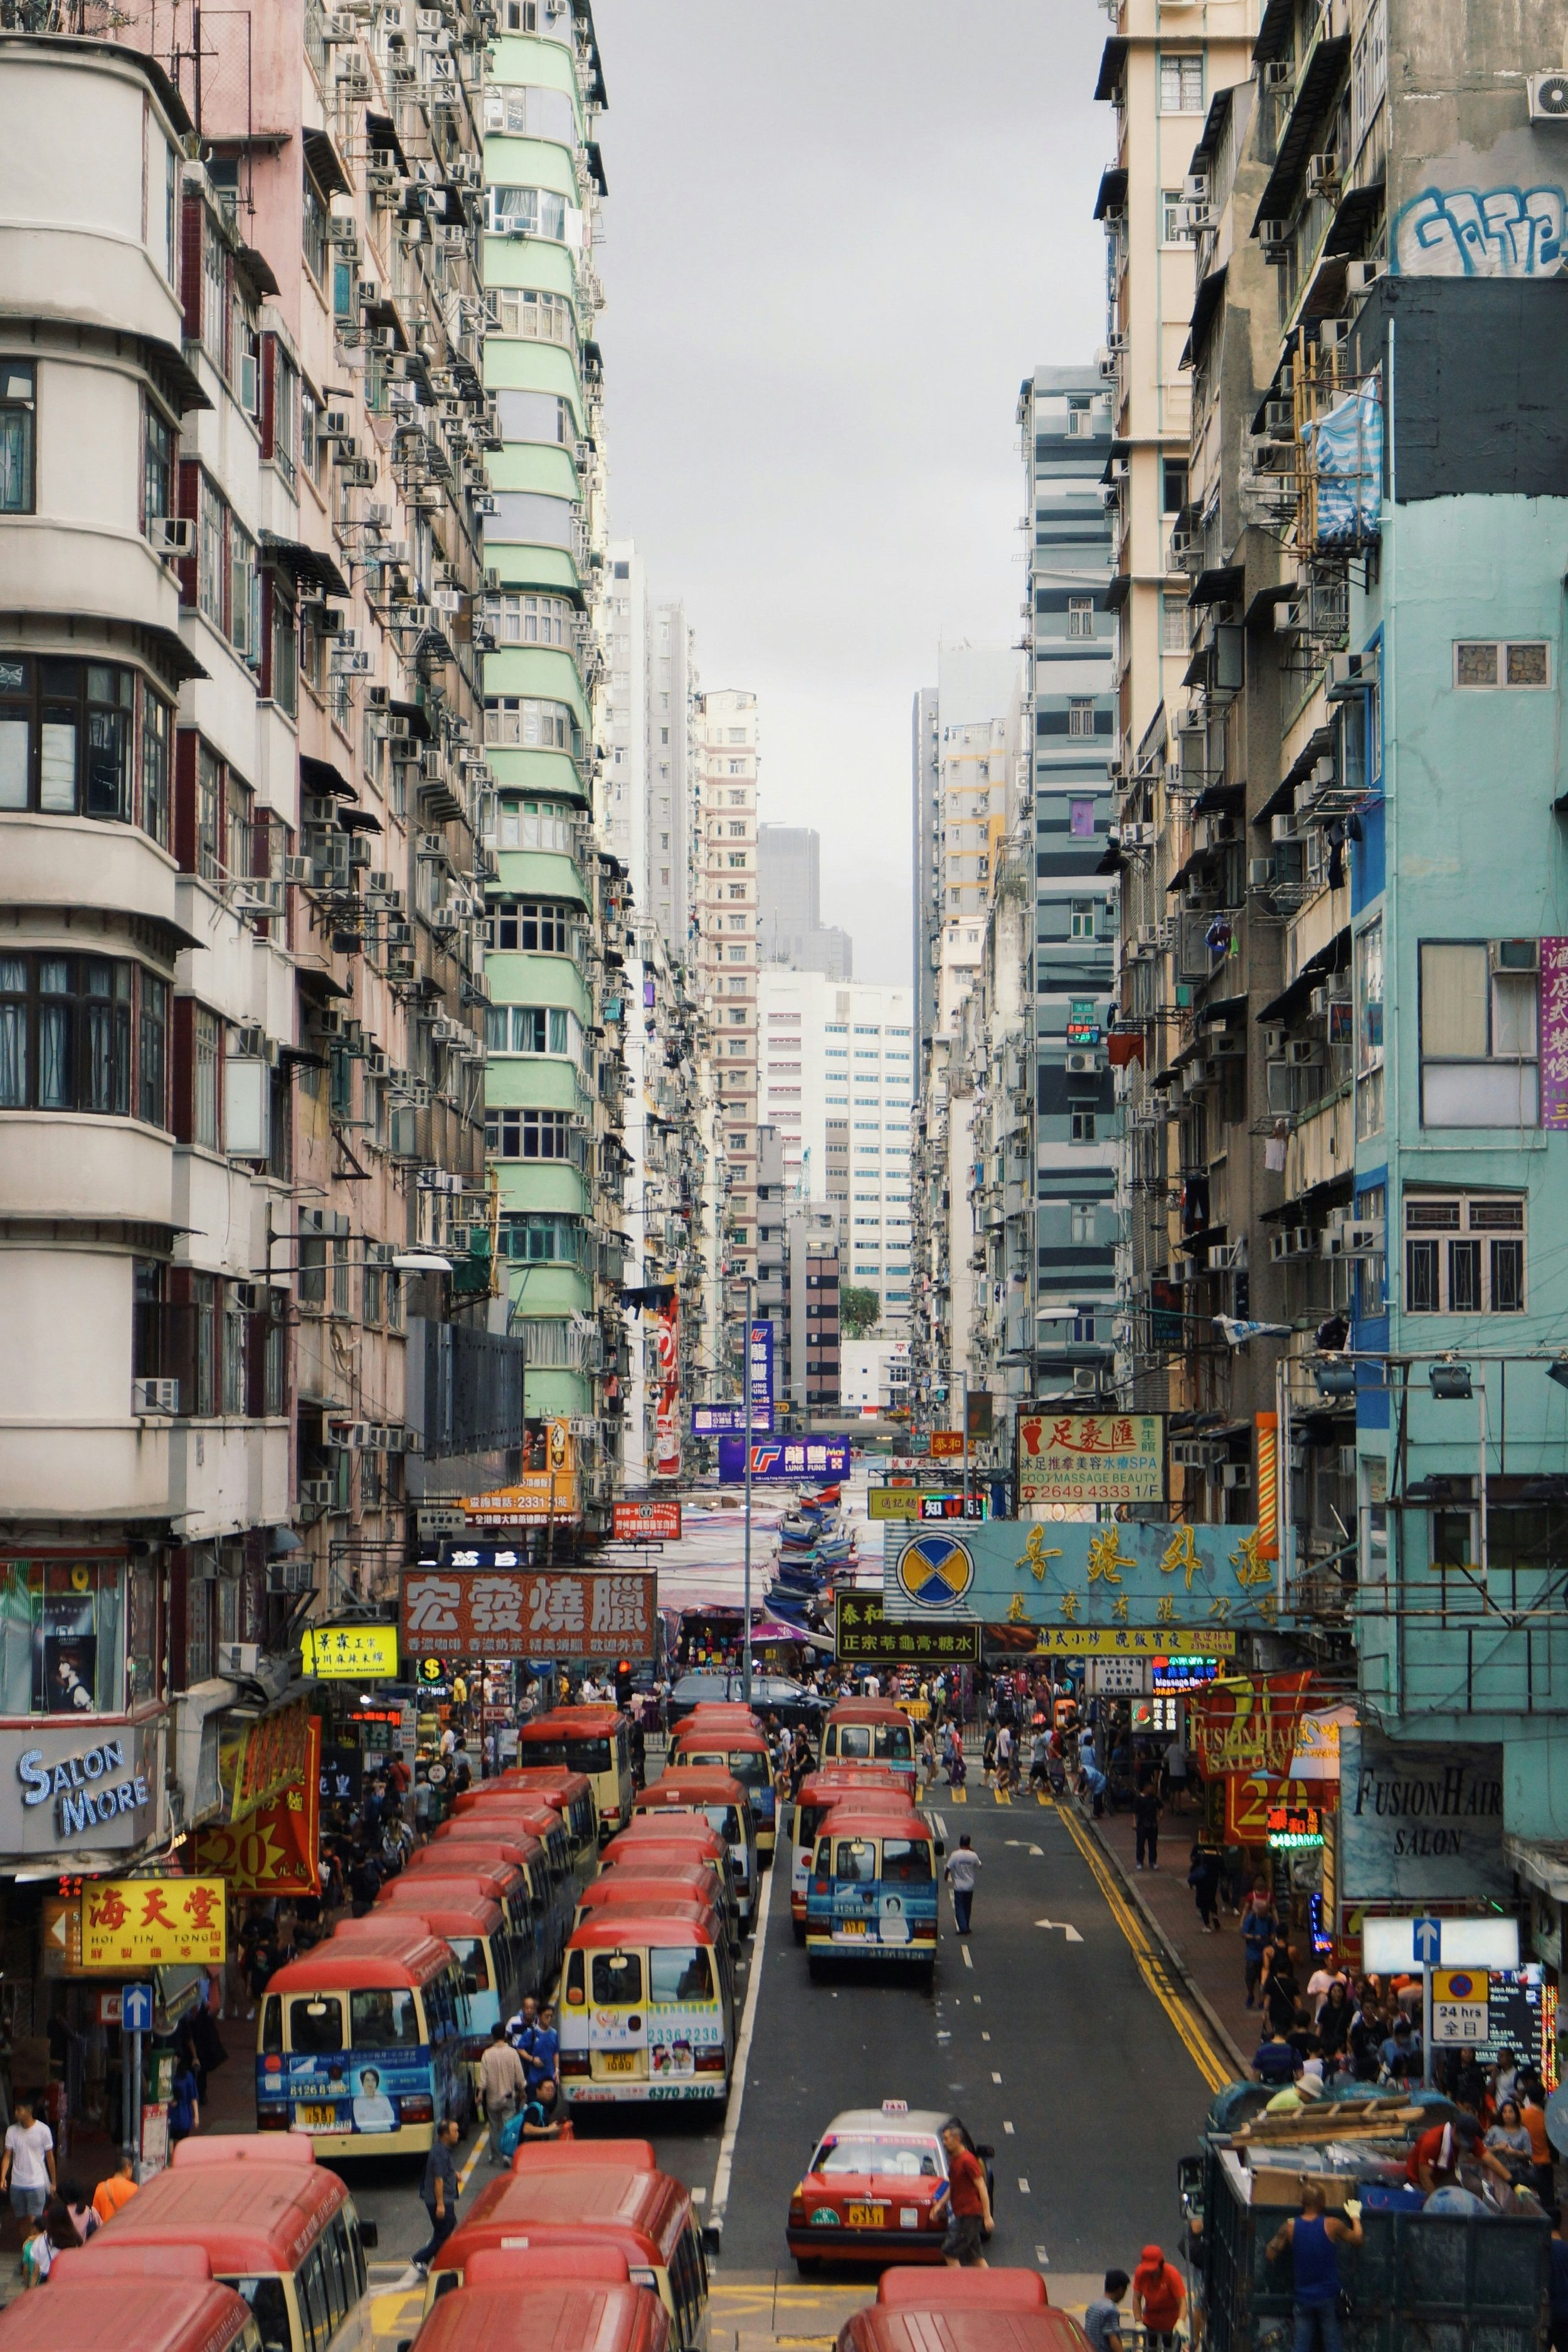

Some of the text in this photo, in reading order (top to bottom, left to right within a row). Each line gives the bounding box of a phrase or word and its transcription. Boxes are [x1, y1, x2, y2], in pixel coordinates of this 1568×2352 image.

[785, 1464, 826, 1472] LUNG FUNG
[1021, 1473, 1157, 1483] FOOT MASSAGE BEAUTY
[1041, 1485, 1158, 1498] 2649 4333 1/F
[18, 1739, 125, 1806] SALON
[62, 1776, 150, 1838] MORE
[1394, 1828, 1463, 1856] SALON
[88, 1885, 221, 1930] 海天堂
[91, 1934, 209, 1944] HOI TIN TONG
[1440, 2005, 1481, 2018] 24 hrs
[684, 2026, 718, 2042] 2238
[1443, 2020, 1477, 2038] 全日
[684, 2085, 716, 2098] 2010
